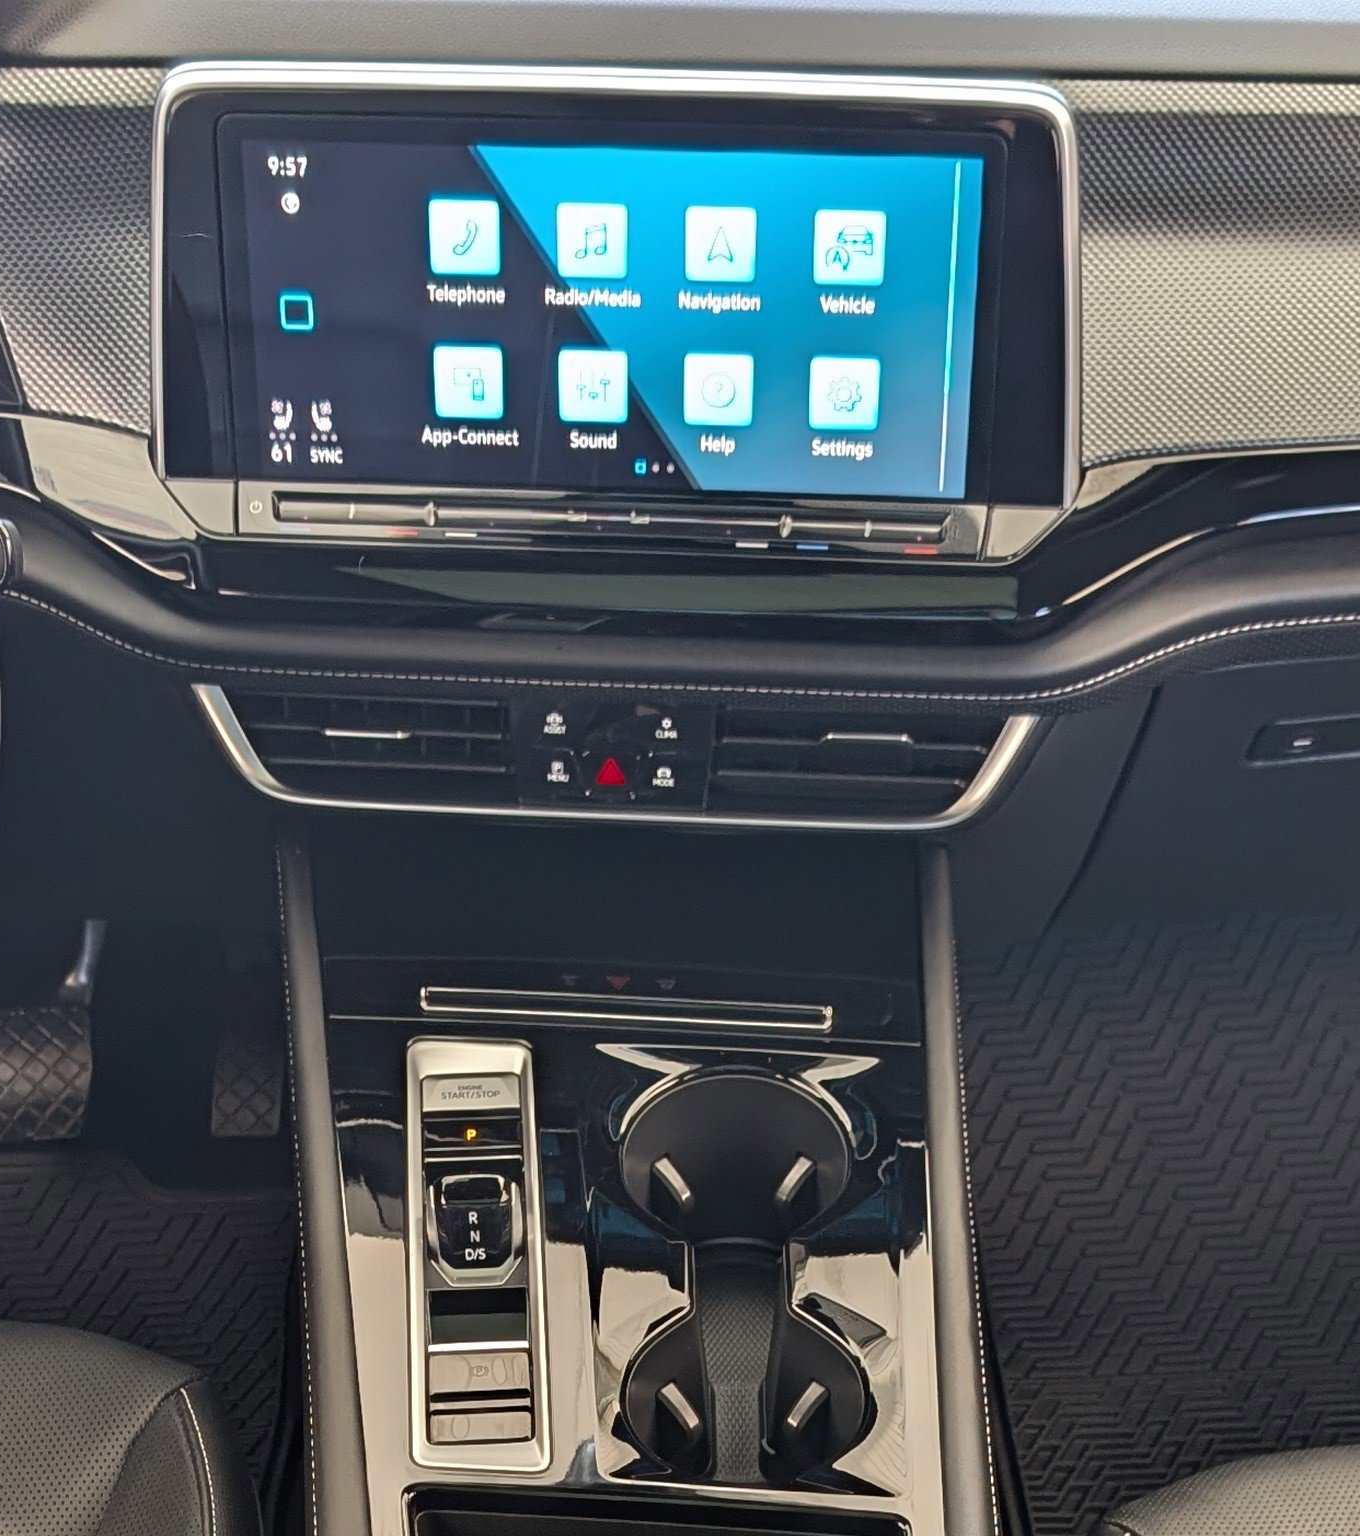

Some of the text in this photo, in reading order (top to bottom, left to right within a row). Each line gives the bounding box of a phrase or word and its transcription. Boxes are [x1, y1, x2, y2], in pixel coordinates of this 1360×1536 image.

[267, 155, 308, 178] 9:57
[427, 284, 506, 307] Telephone
[545, 287, 641, 308] Radio/Media
[678, 290, 761, 314] Navigation
[820, 294, 876, 315] Vehicle
[421, 426, 520, 447] App-Connect
[570, 429, 618, 450] Sound
[700, 434, 736, 456] Help
[271, 442, 292, 463] 61
[309, 446, 344, 464] SYNC
[811, 438, 873, 461] Settings
[654, 729, 679, 739] CLIMA
[547, 774, 570, 782] MENU
[652, 778, 675, 787] MODE
[441, 1090, 501, 1100] START/STOP
[466, 1129, 477, 1141] P
[468, 1211, 478, 1225] R
[470, 1230, 481, 1243] N
[465, 1248, 487, 1261] D/S
